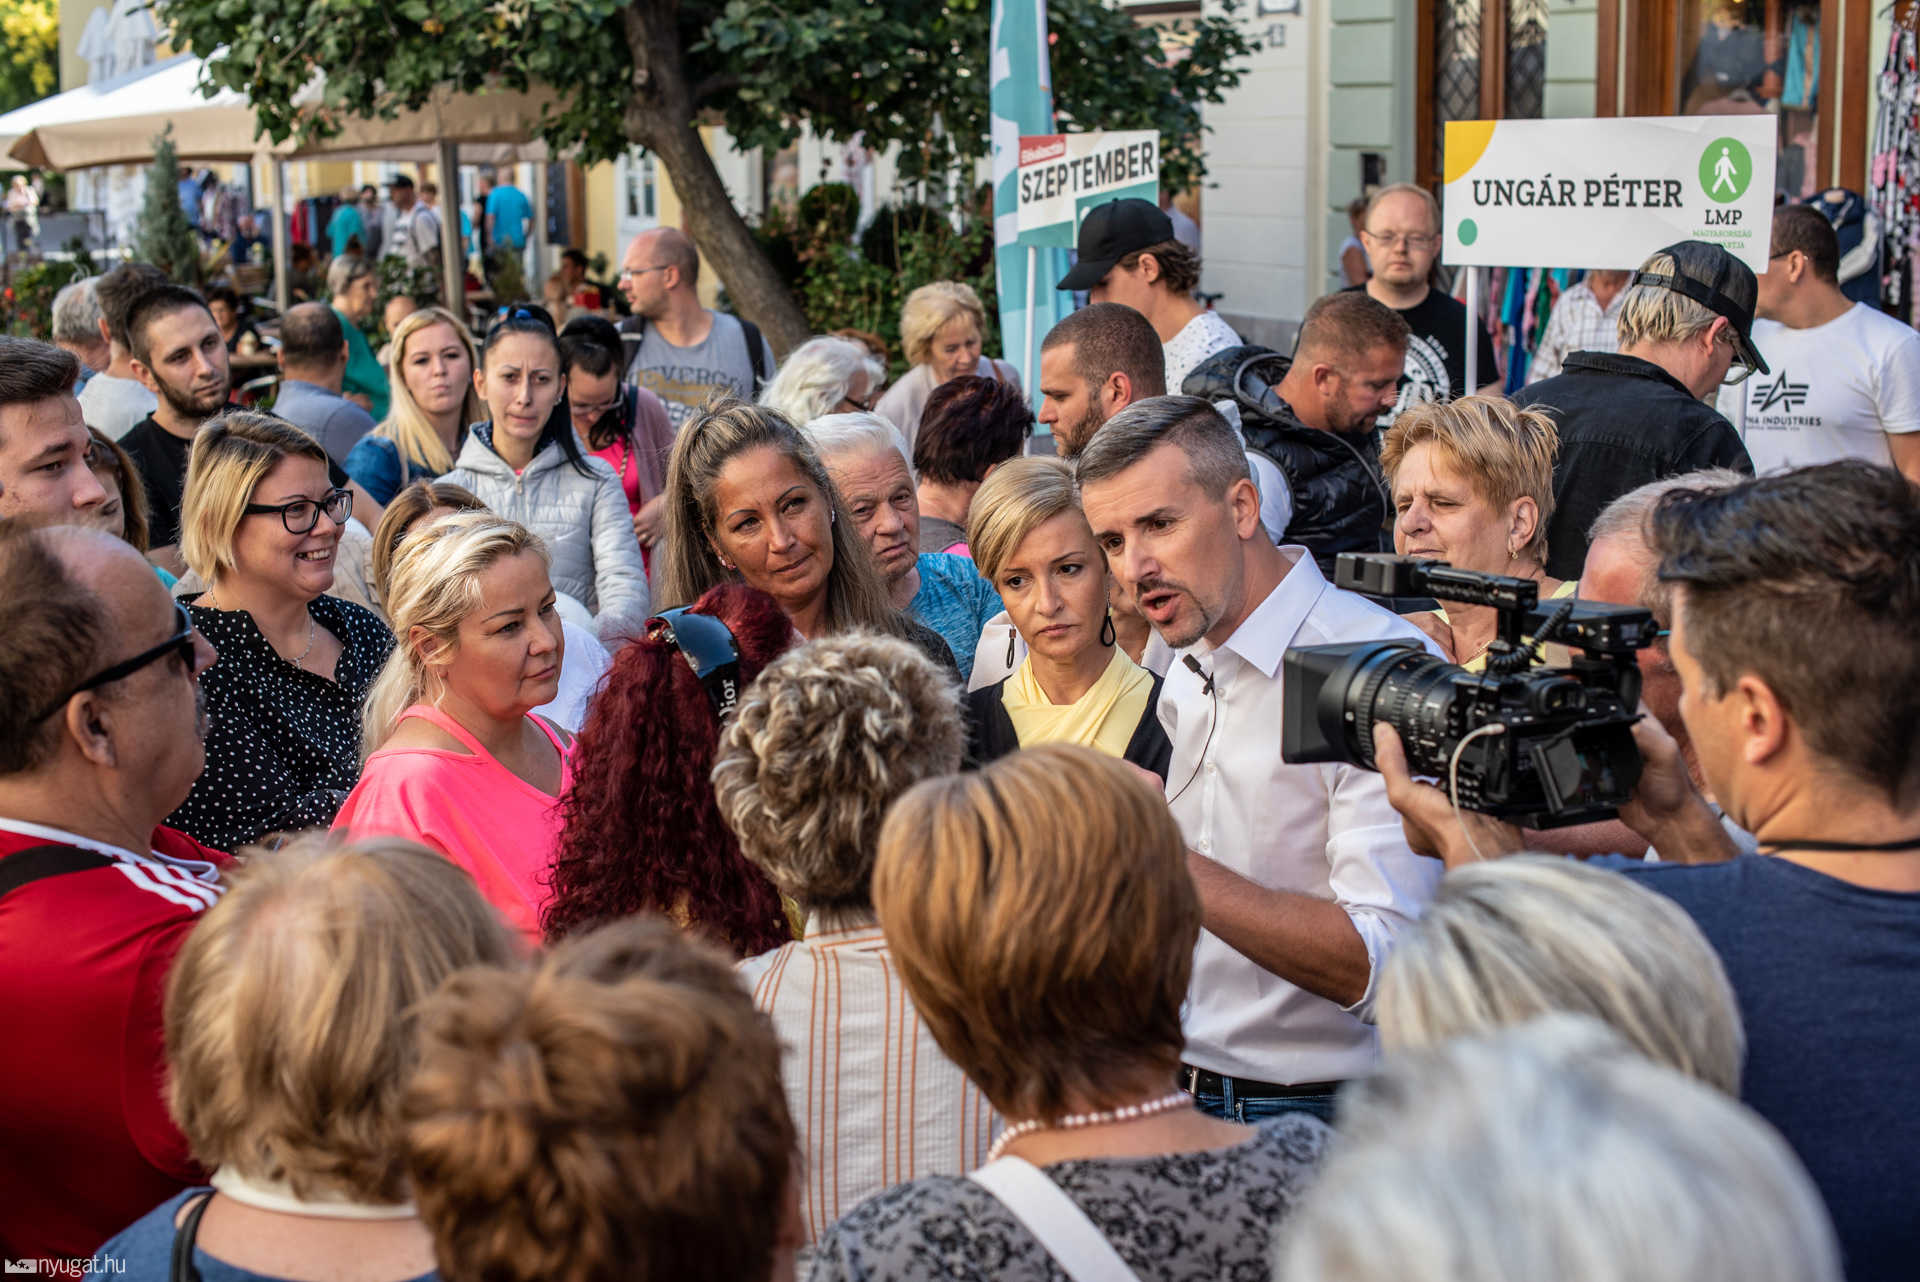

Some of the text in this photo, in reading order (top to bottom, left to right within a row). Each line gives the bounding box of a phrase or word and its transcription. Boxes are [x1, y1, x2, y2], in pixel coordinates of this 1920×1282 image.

[1021, 141, 1154, 204] SZEPTEMBER
[1472, 173, 1683, 207] UNGÁR PÉTER
[1704, 209, 1743, 225] LMP
[1762, 416, 1822, 427] INDUSTRIES
